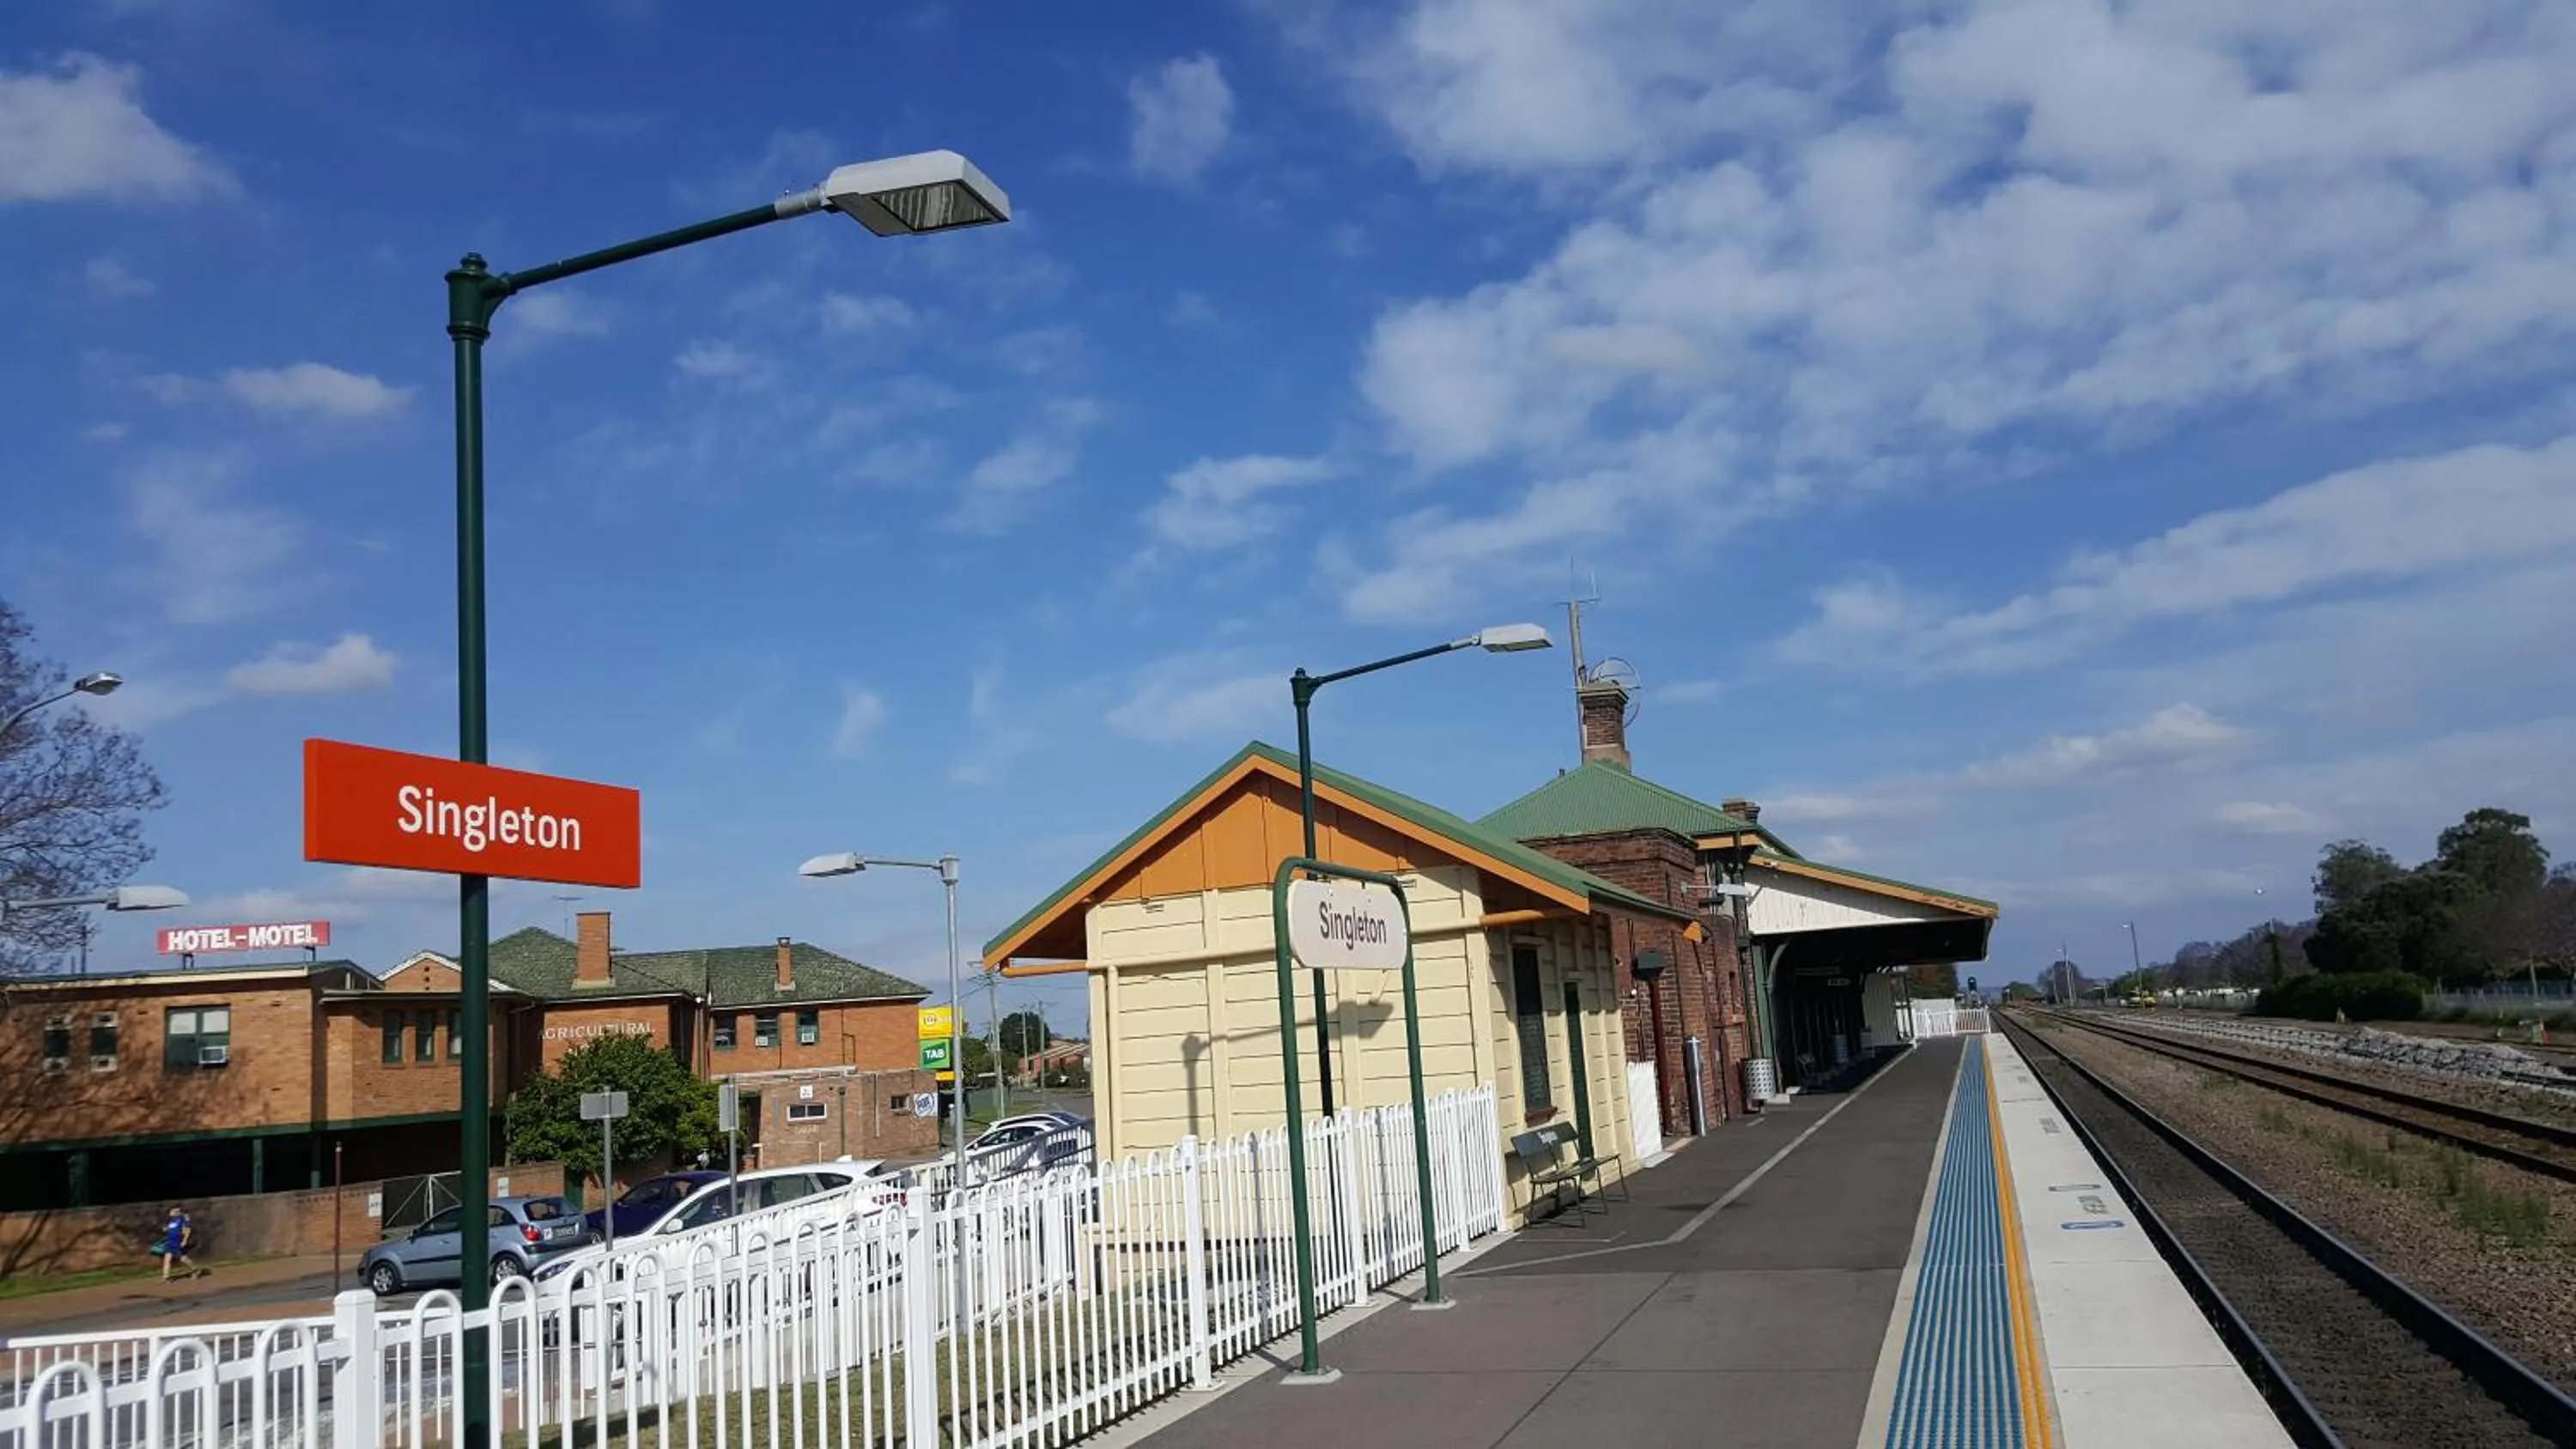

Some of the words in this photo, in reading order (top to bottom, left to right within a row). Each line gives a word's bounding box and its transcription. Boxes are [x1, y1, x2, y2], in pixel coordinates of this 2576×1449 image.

[398, 785, 581, 852] Singleton
[167, 924, 319, 950] HOTEL-MOTEL
[1319, 900, 1388, 951] Singleton
[924, 1048, 945, 1059] TAB
